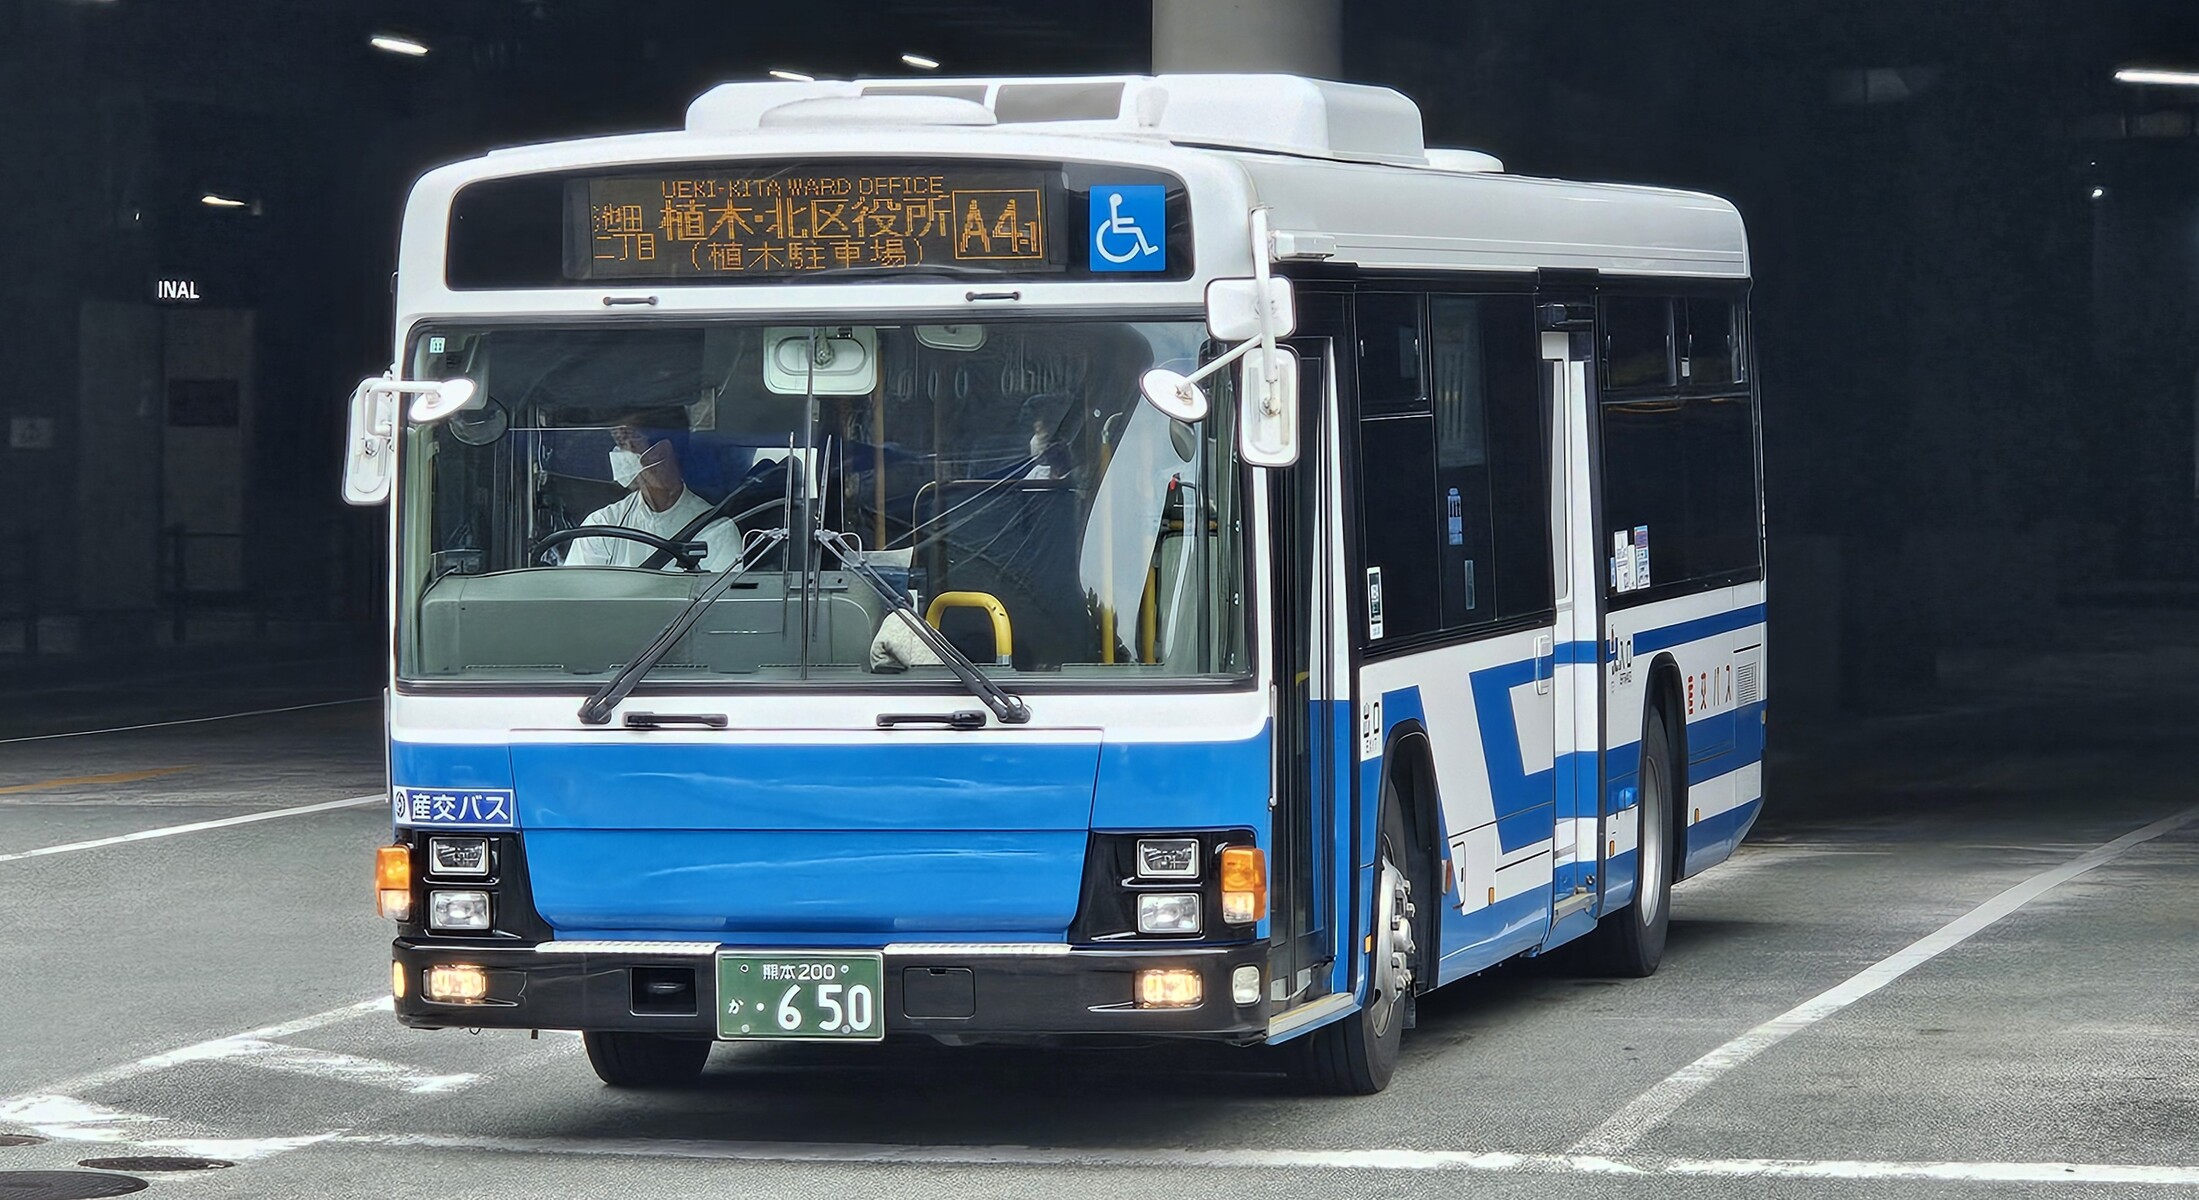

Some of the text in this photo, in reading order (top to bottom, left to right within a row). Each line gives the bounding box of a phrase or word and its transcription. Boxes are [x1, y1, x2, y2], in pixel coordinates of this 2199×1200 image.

[662, 176, 944, 198] UEKI-KITA WARD OFFICE
[158, 280, 200, 299] INAL
[412, 793, 509, 820] 産交バス
[728, 999, 744, 1014] か
